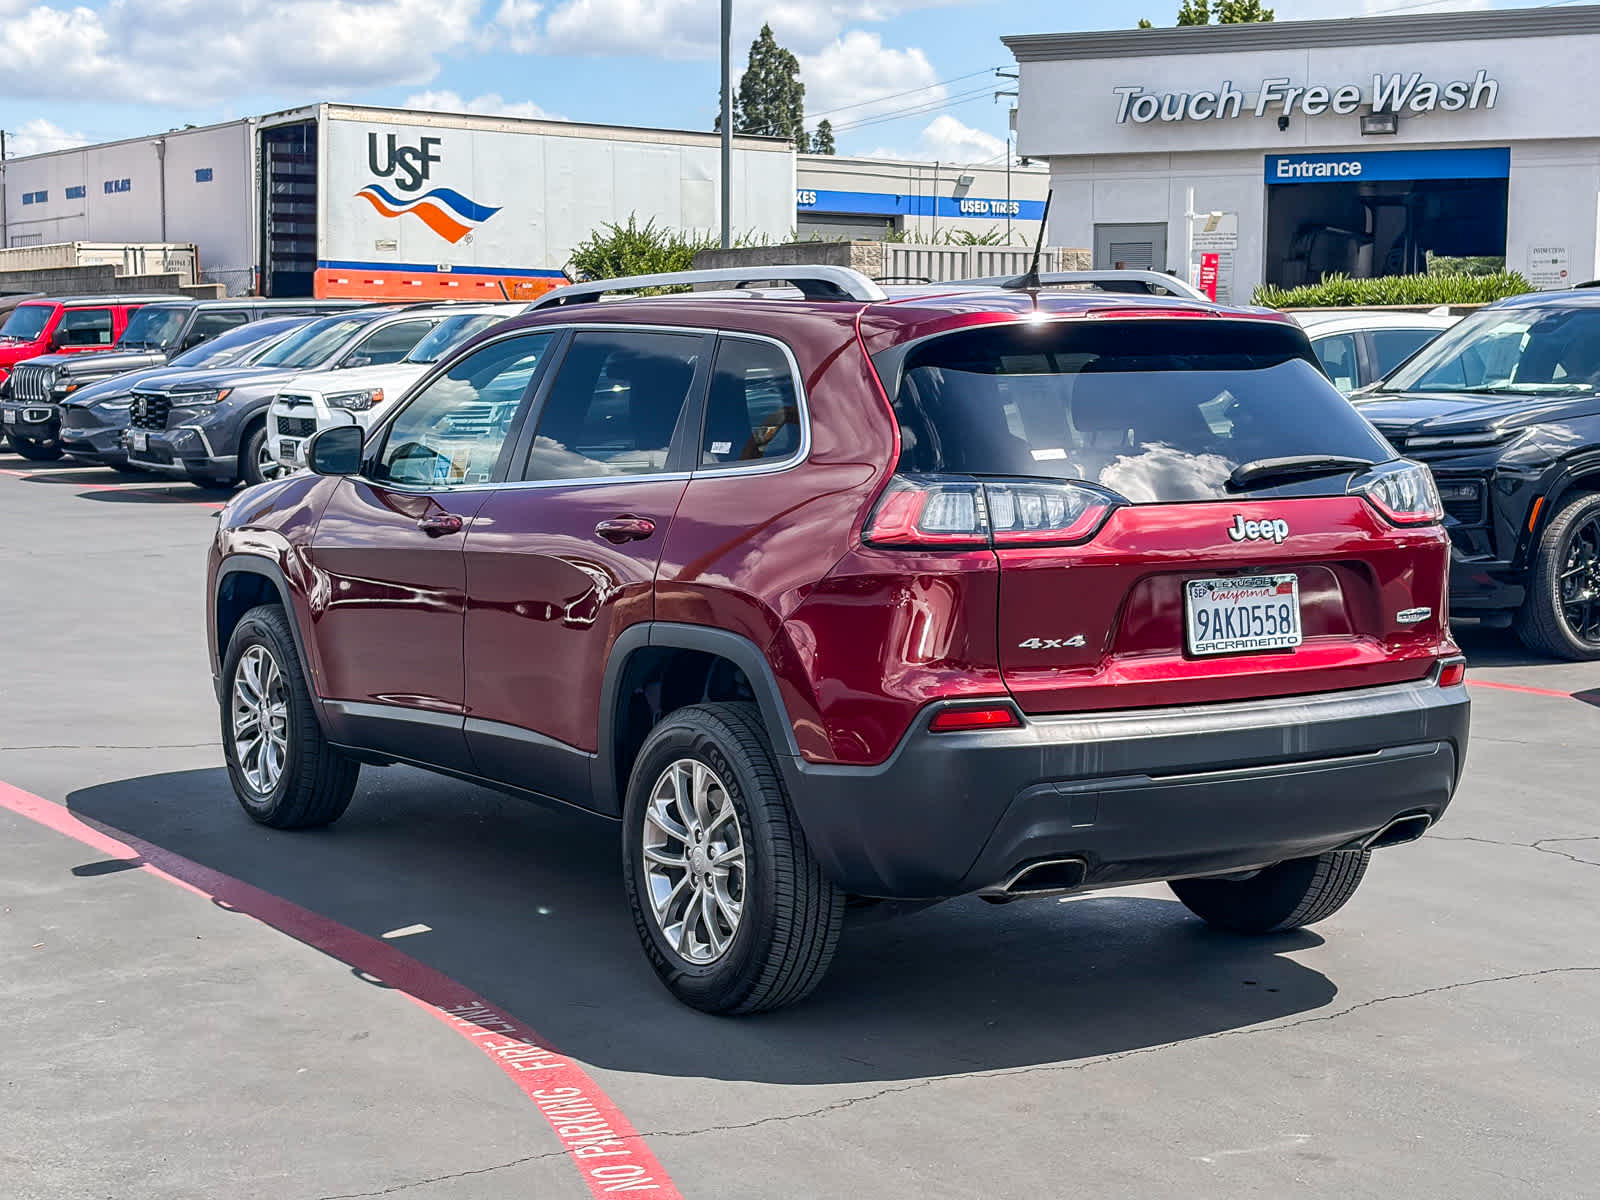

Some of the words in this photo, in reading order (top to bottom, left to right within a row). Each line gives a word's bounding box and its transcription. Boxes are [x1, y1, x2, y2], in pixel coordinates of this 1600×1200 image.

[1112, 80, 1243, 123] Touch
[1255, 77, 1360, 117] Free
[1371, 69, 1499, 113] Wash
[368, 132, 442, 192] USF
[1276, 159, 1362, 178] Entrance
[960, 199, 989, 214] USED
[990, 201, 1020, 215] TIRES
[1228, 514, 1289, 544] Jeep
[1193, 587, 1207, 599] SEP
[1211, 588, 1276, 604] California
[1197, 603, 1292, 641] 9AKD558
[1018, 634, 1087, 649] 4x4
[1195, 636, 1298, 652] SACRAMENTO
[483, 1037, 567, 1072] FIRE
[532, 1087, 633, 1159] PARKING
[591, 1164, 660, 1192] NO
